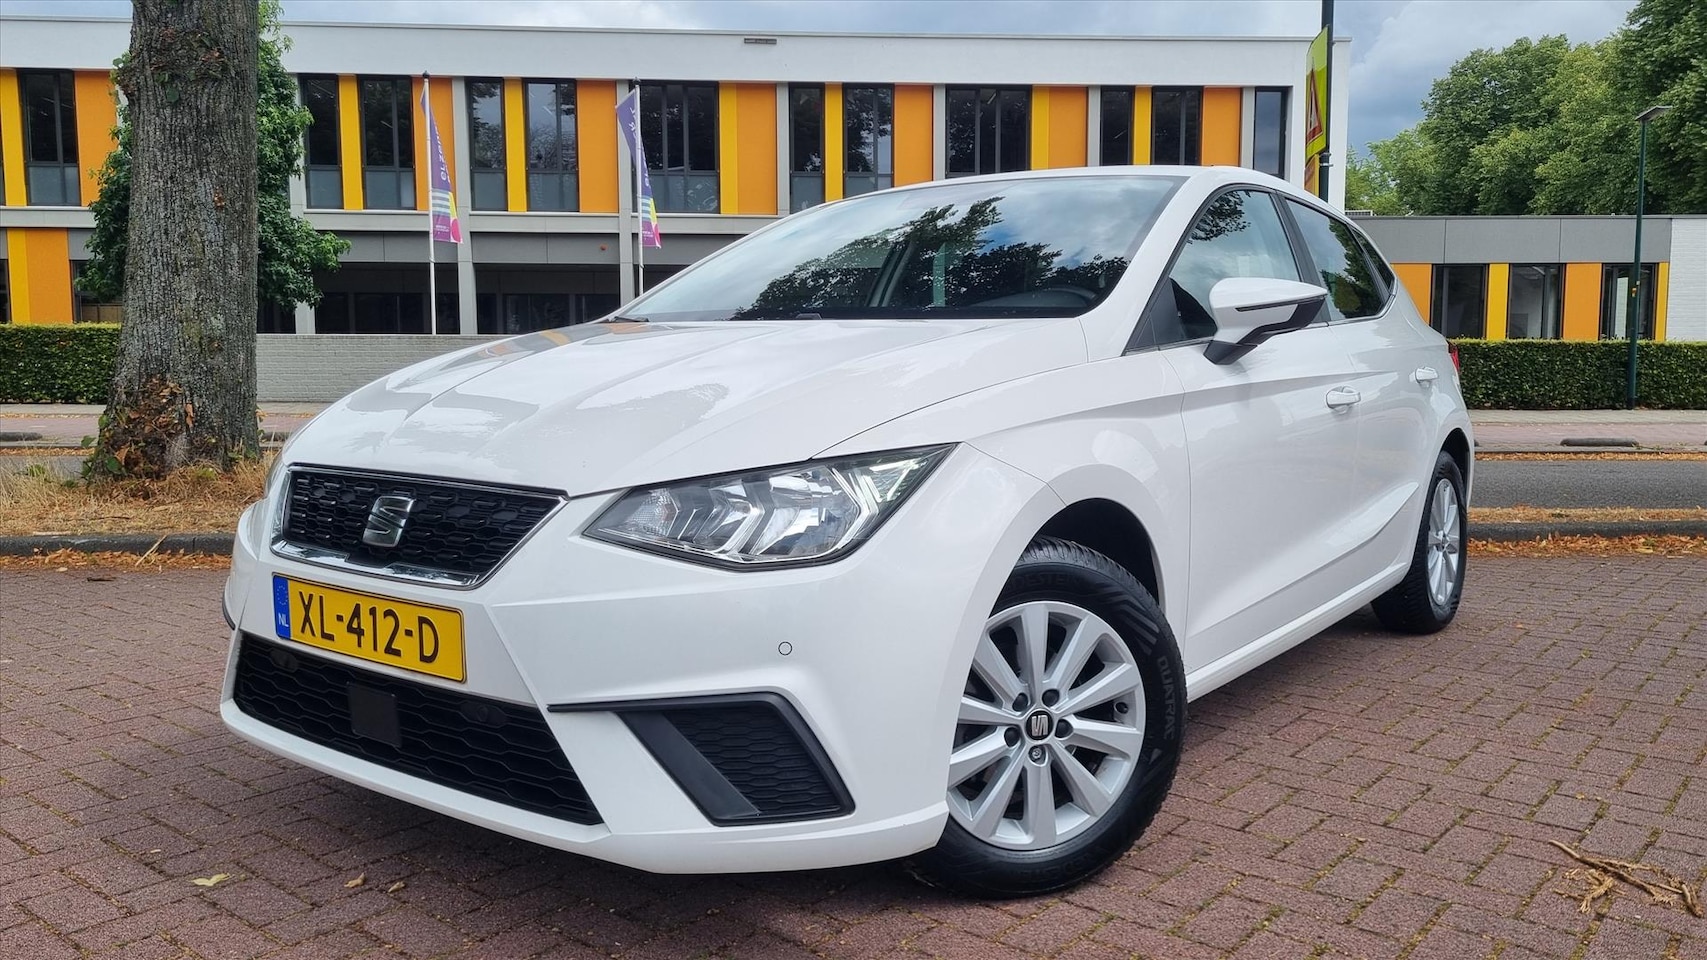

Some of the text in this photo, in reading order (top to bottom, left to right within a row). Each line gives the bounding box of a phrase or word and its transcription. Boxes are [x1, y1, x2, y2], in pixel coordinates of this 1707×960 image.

[277, 613, 289, 628] NL
[299, 591, 439, 664] XL-412-D
[1157, 656, 1176, 740] QUATRAC
